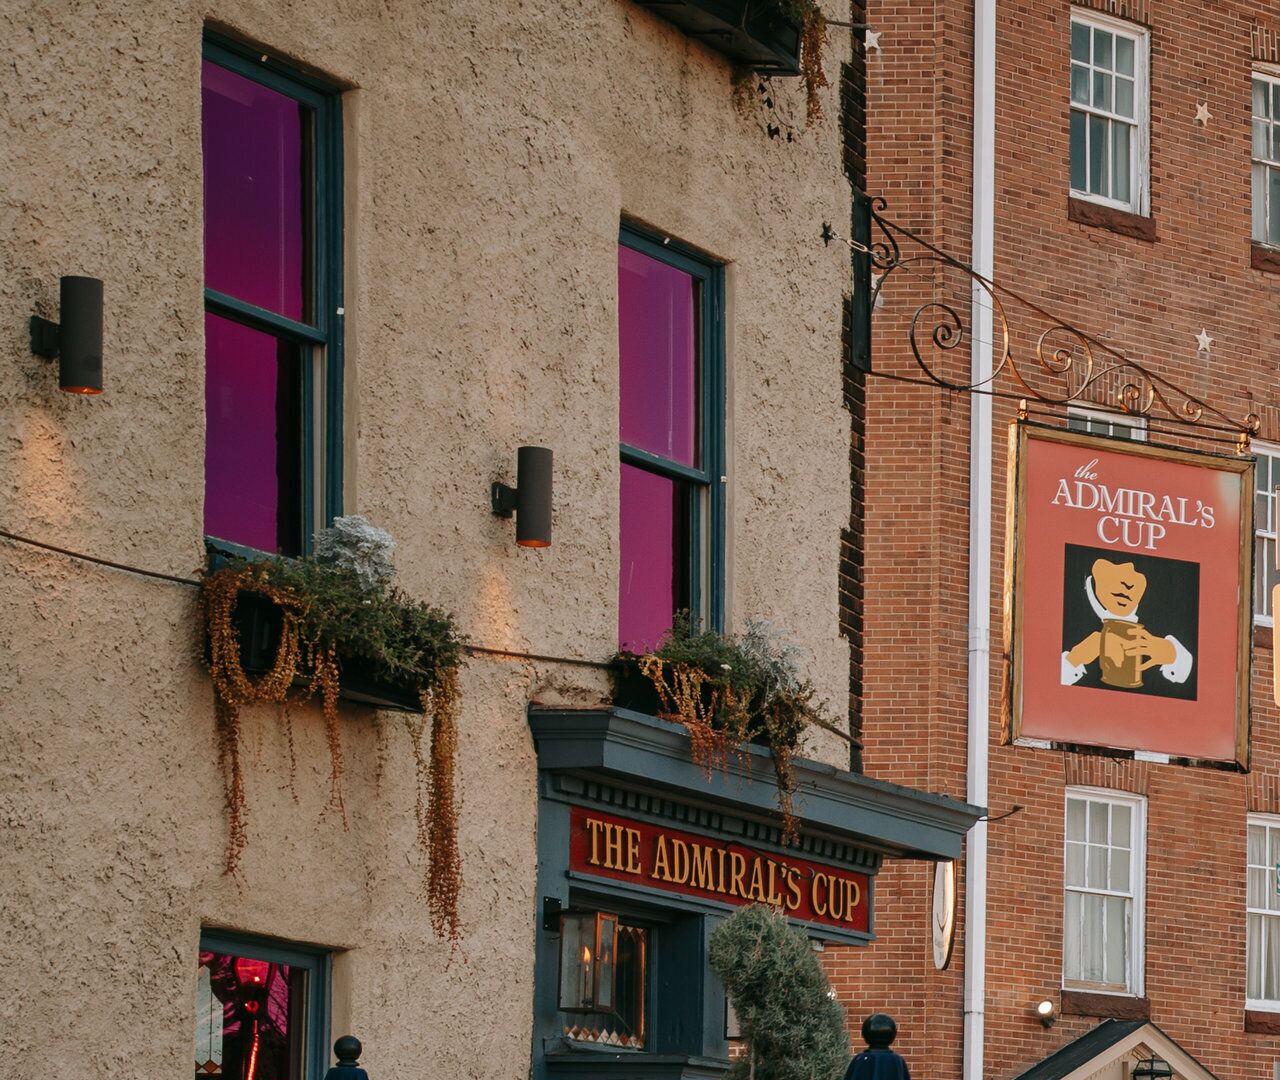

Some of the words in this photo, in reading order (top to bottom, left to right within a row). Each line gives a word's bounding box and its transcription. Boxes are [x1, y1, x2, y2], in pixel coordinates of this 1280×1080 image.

[1074, 458, 1099, 481] the
[1096, 515, 1167, 550] CUP
[586, 817, 641, 875] THE
[651, 834, 802, 911] ADMIRAL'S
[812, 872, 861, 922] CUP
